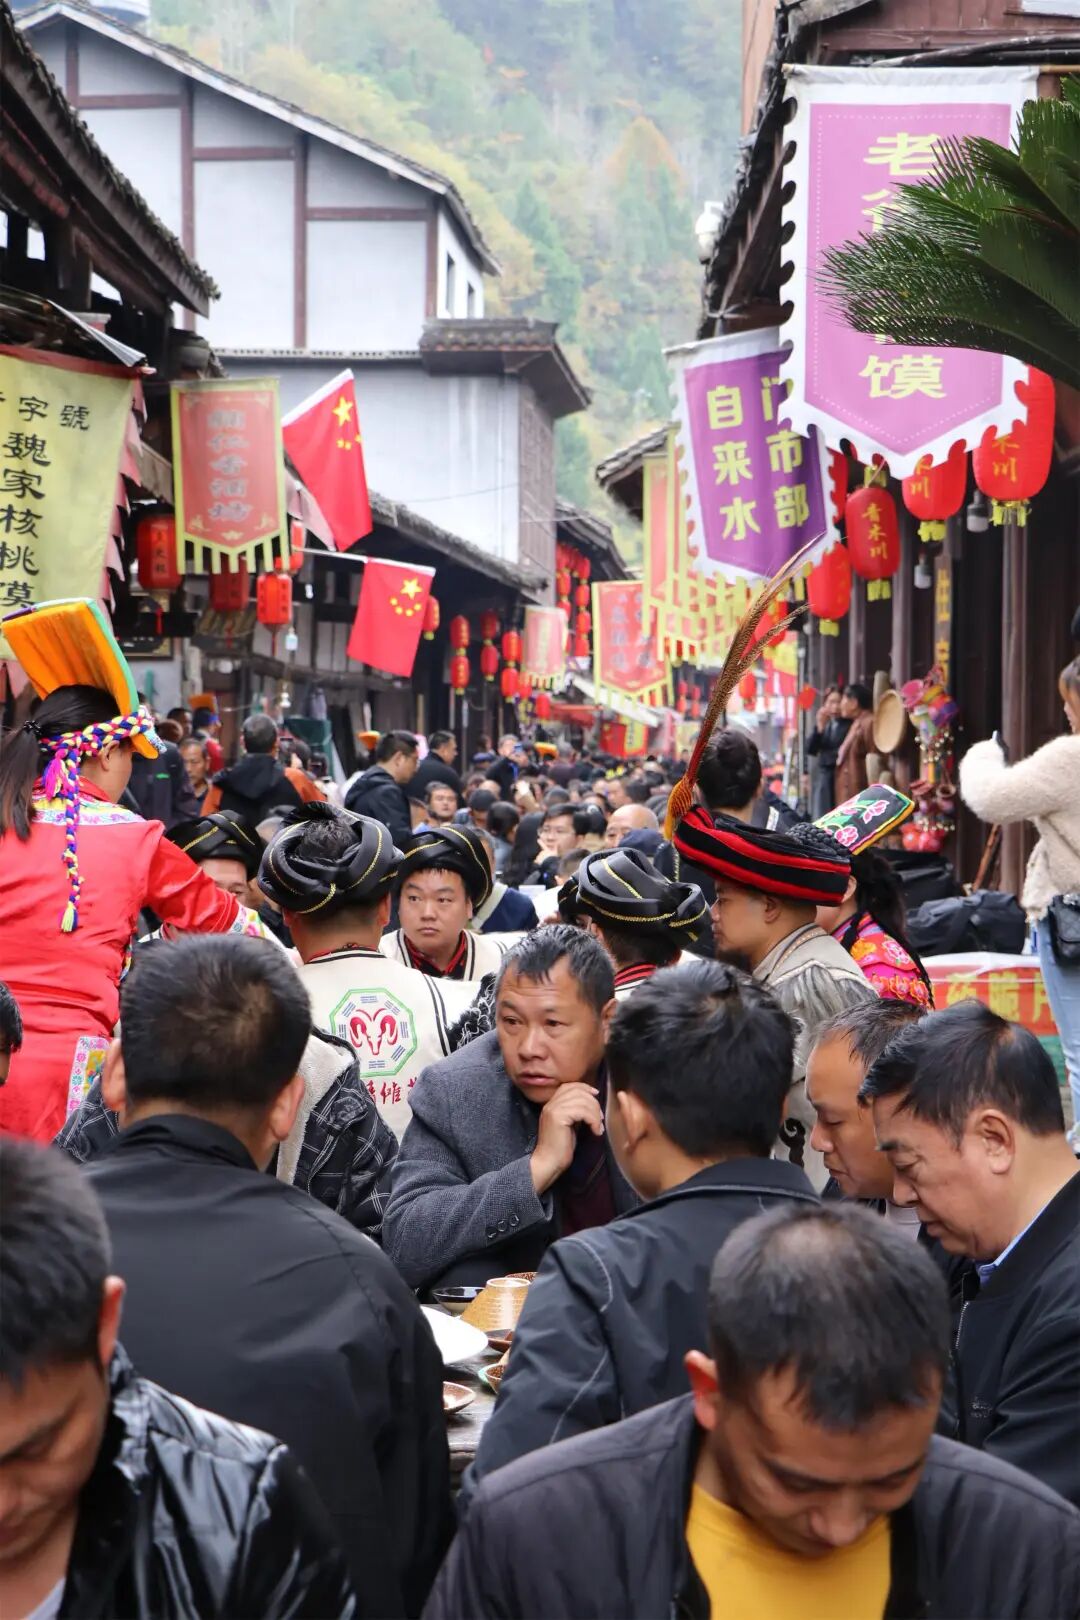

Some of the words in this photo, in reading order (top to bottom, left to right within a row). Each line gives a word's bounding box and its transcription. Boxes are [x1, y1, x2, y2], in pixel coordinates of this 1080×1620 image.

[0, 390, 90, 431] 字號
[707, 385, 762, 541] 自来水
[862, 502, 888, 560] 青木川
